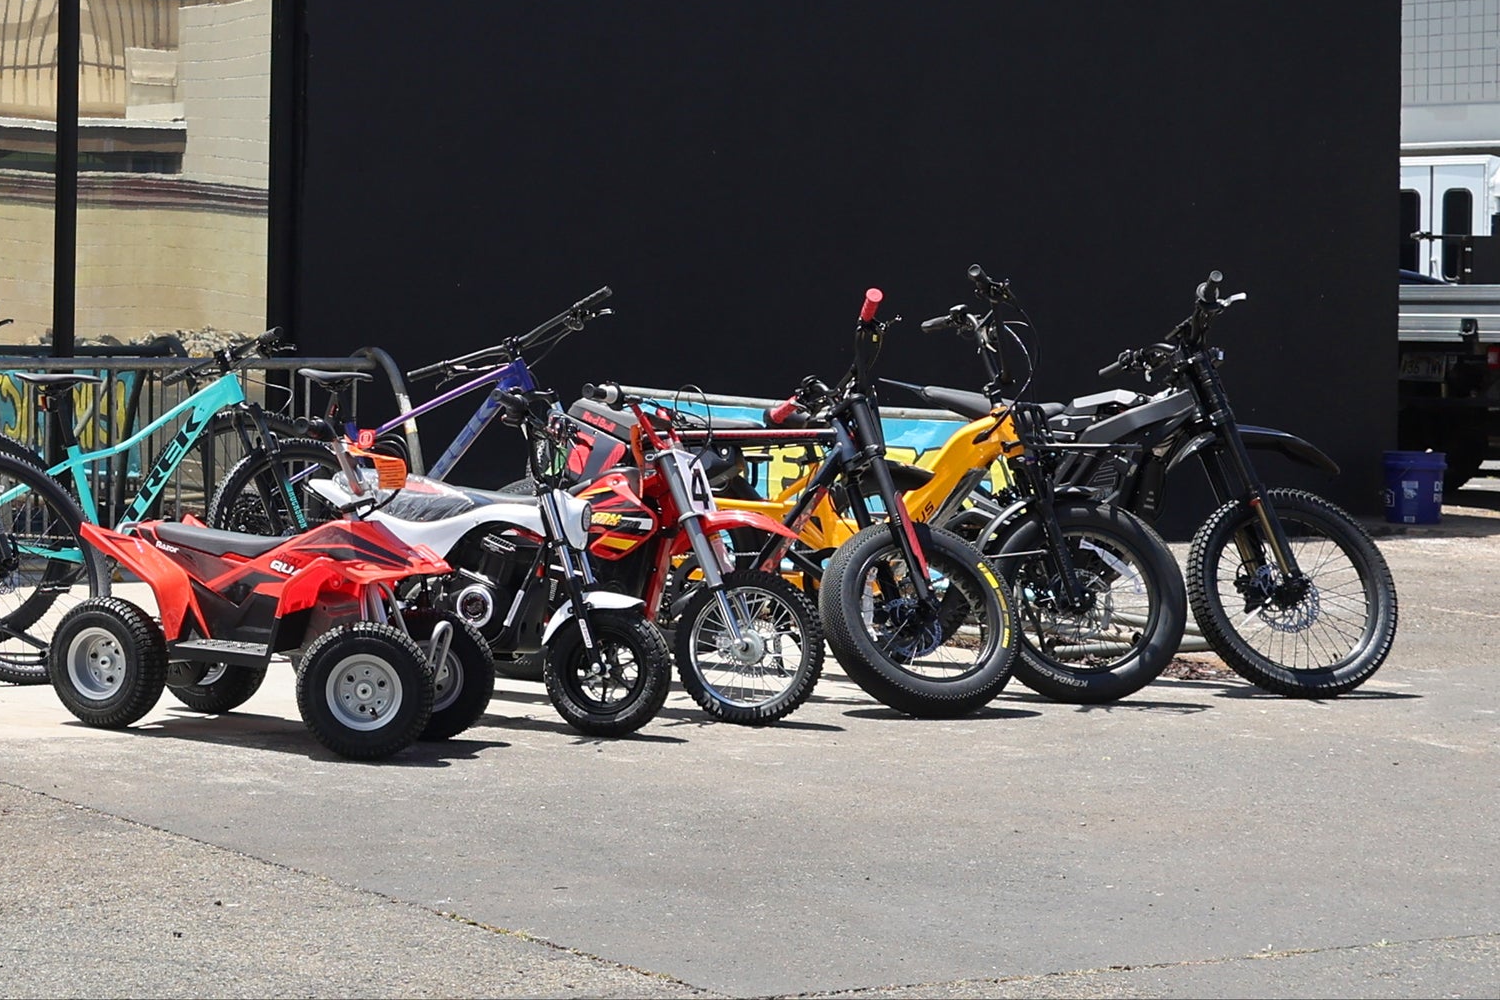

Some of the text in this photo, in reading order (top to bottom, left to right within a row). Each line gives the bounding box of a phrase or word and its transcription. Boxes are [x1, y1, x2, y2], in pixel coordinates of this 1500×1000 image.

[117, 406, 202, 524] TREK
[692, 468, 710, 510] 4
[1053, 674, 1089, 688] KENDA
